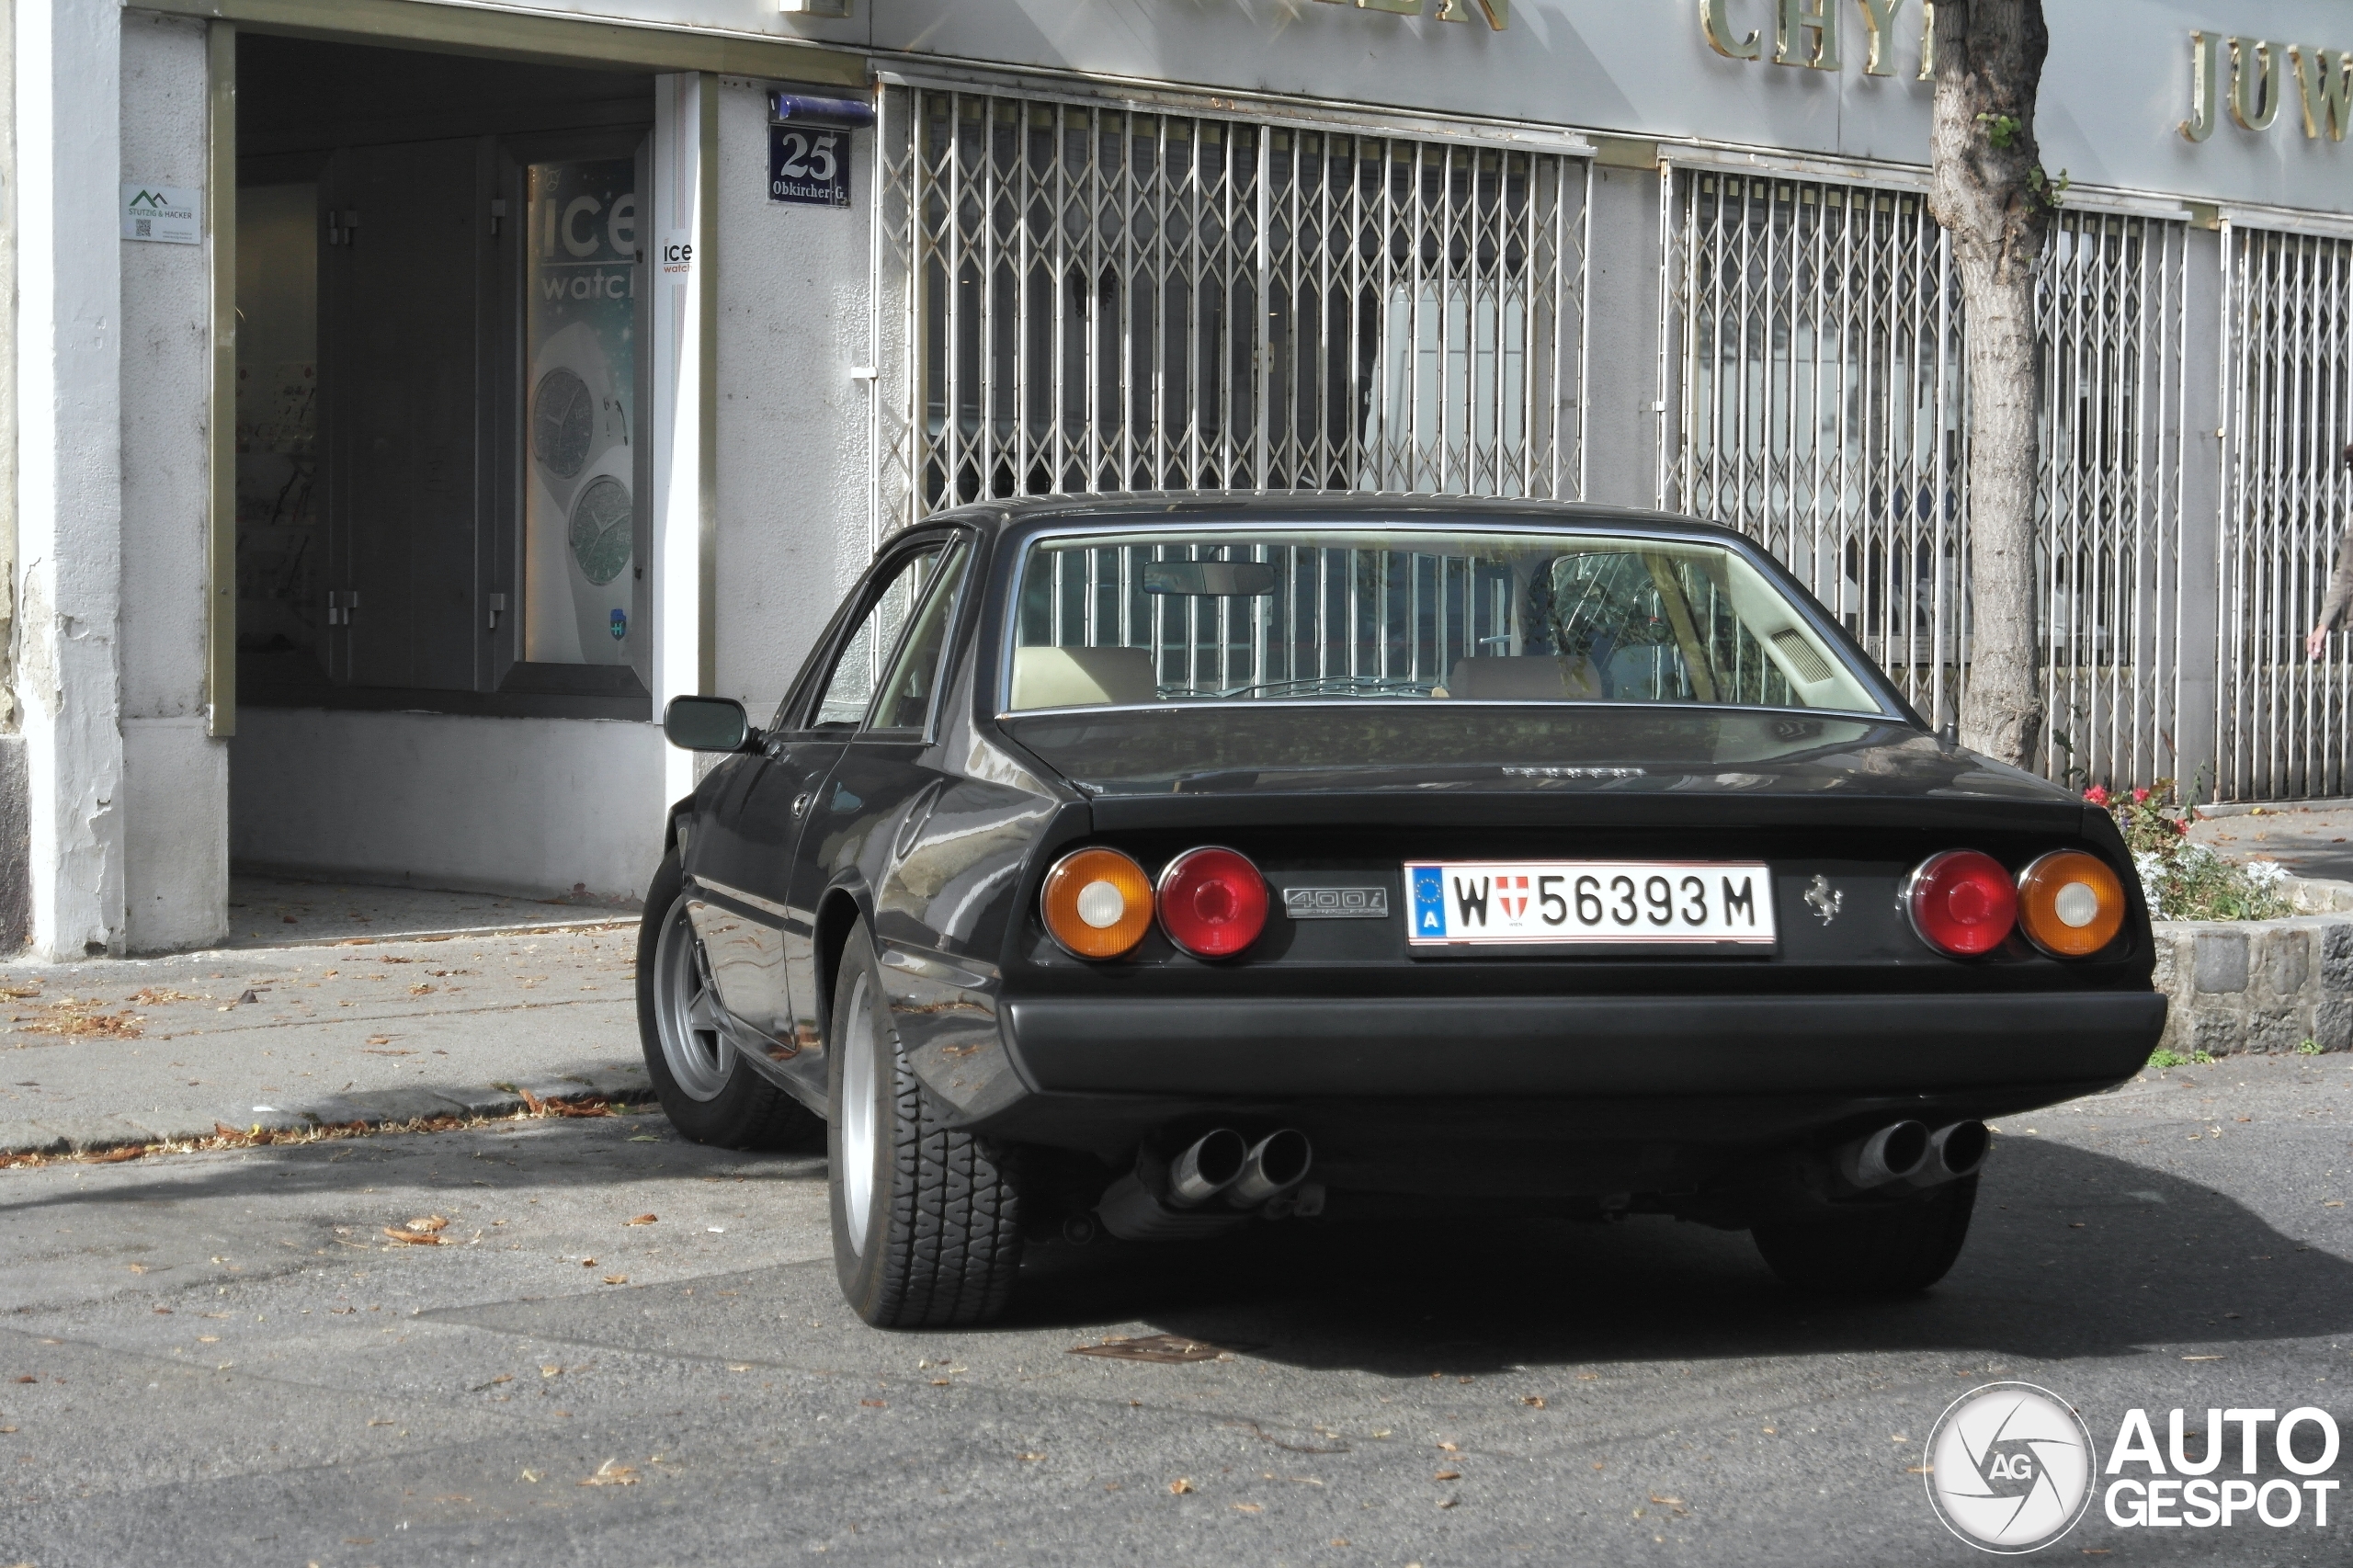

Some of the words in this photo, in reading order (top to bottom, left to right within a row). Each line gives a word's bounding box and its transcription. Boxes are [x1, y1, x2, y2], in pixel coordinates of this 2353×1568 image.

[1699, 0, 1936, 81] CHY
[2177, 29, 2353, 143] JUW
[780, 132, 837, 181] 25
[129, 208, 157, 217] STUTZIG
[165, 211, 192, 220] HACKER
[544, 193, 634, 257] ice
[664, 244, 693, 262] ice
[1289, 891, 1381, 908] 400i
[1423, 912, 1439, 928] A
[1453, 875, 1490, 927] W
[1538, 875, 1708, 926] 56393
[1722, 875, 1756, 926] M
